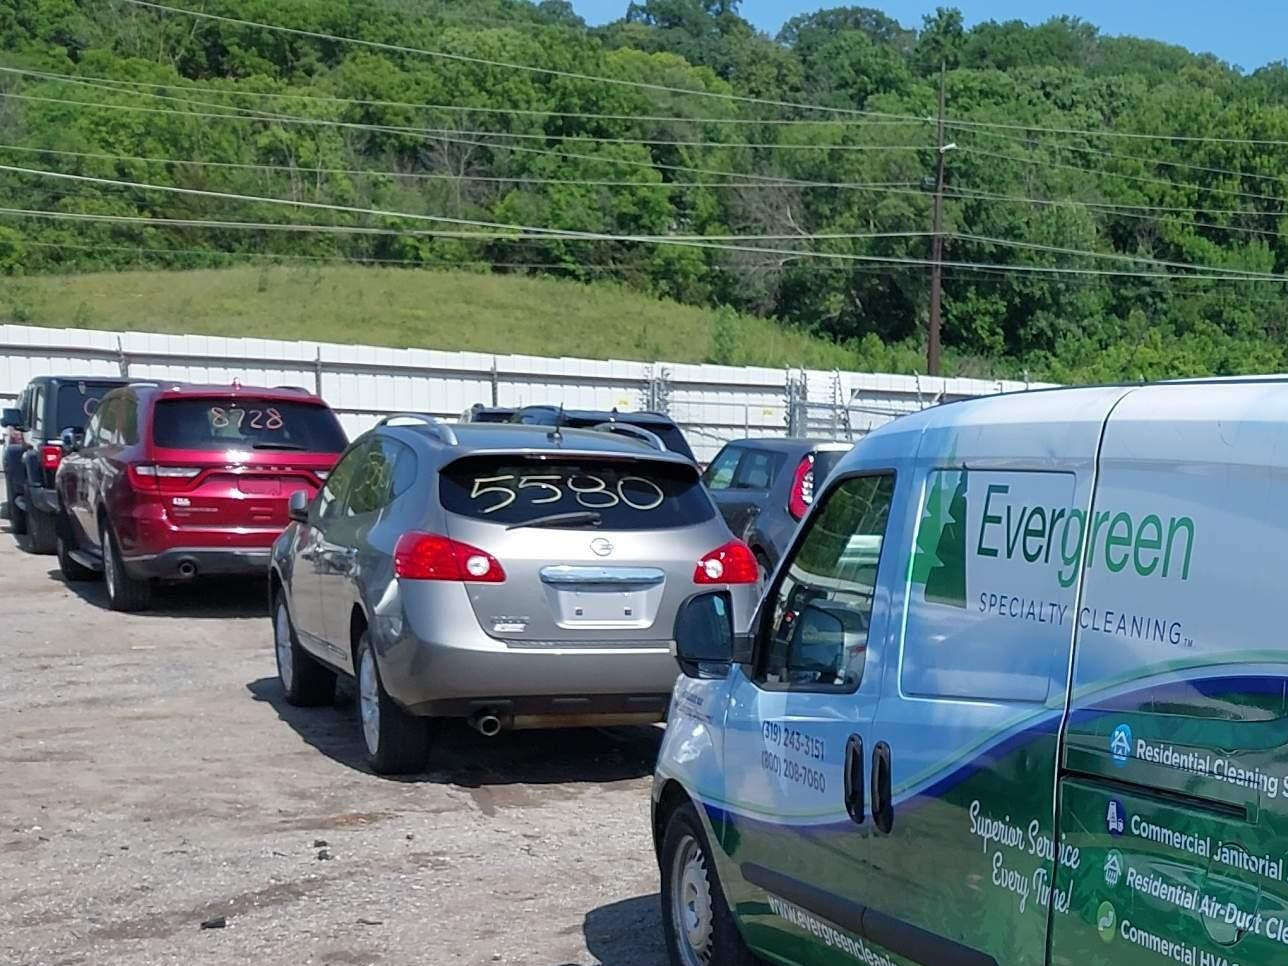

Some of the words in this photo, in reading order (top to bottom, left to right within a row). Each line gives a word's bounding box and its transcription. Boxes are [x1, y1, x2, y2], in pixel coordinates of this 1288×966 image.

[210, 407, 284, 430] 8728
[470, 474, 664, 514] 5580
[977, 484, 1195, 588] Evergreen
[978, 592, 1068, 625] SPECIALTY
[1079, 607, 1182, 645] CLEANING
[762, 720, 782, 746] (319)
[783, 729, 825, 761] 243-3151
[1136, 739, 1211, 776] Residential
[1213, 759, 1279, 798] Cleaning
[761, 751, 782, 777] (800)
[783, 759, 826, 793] 208-7060
[969, 800, 1026, 854] Superior
[1028, 819, 1081, 869] Service
[1130, 815, 1212, 857] Commercial
[1213, 844, 1283, 881] Janitorial
[991, 851, 1030, 913] Every
[1033, 867, 1074, 915] Time!
[1126, 867, 1198, 911] Residential
[1198, 895, 1261, 934] Air-Duct
[1120, 919, 1198, 966] Commercial
